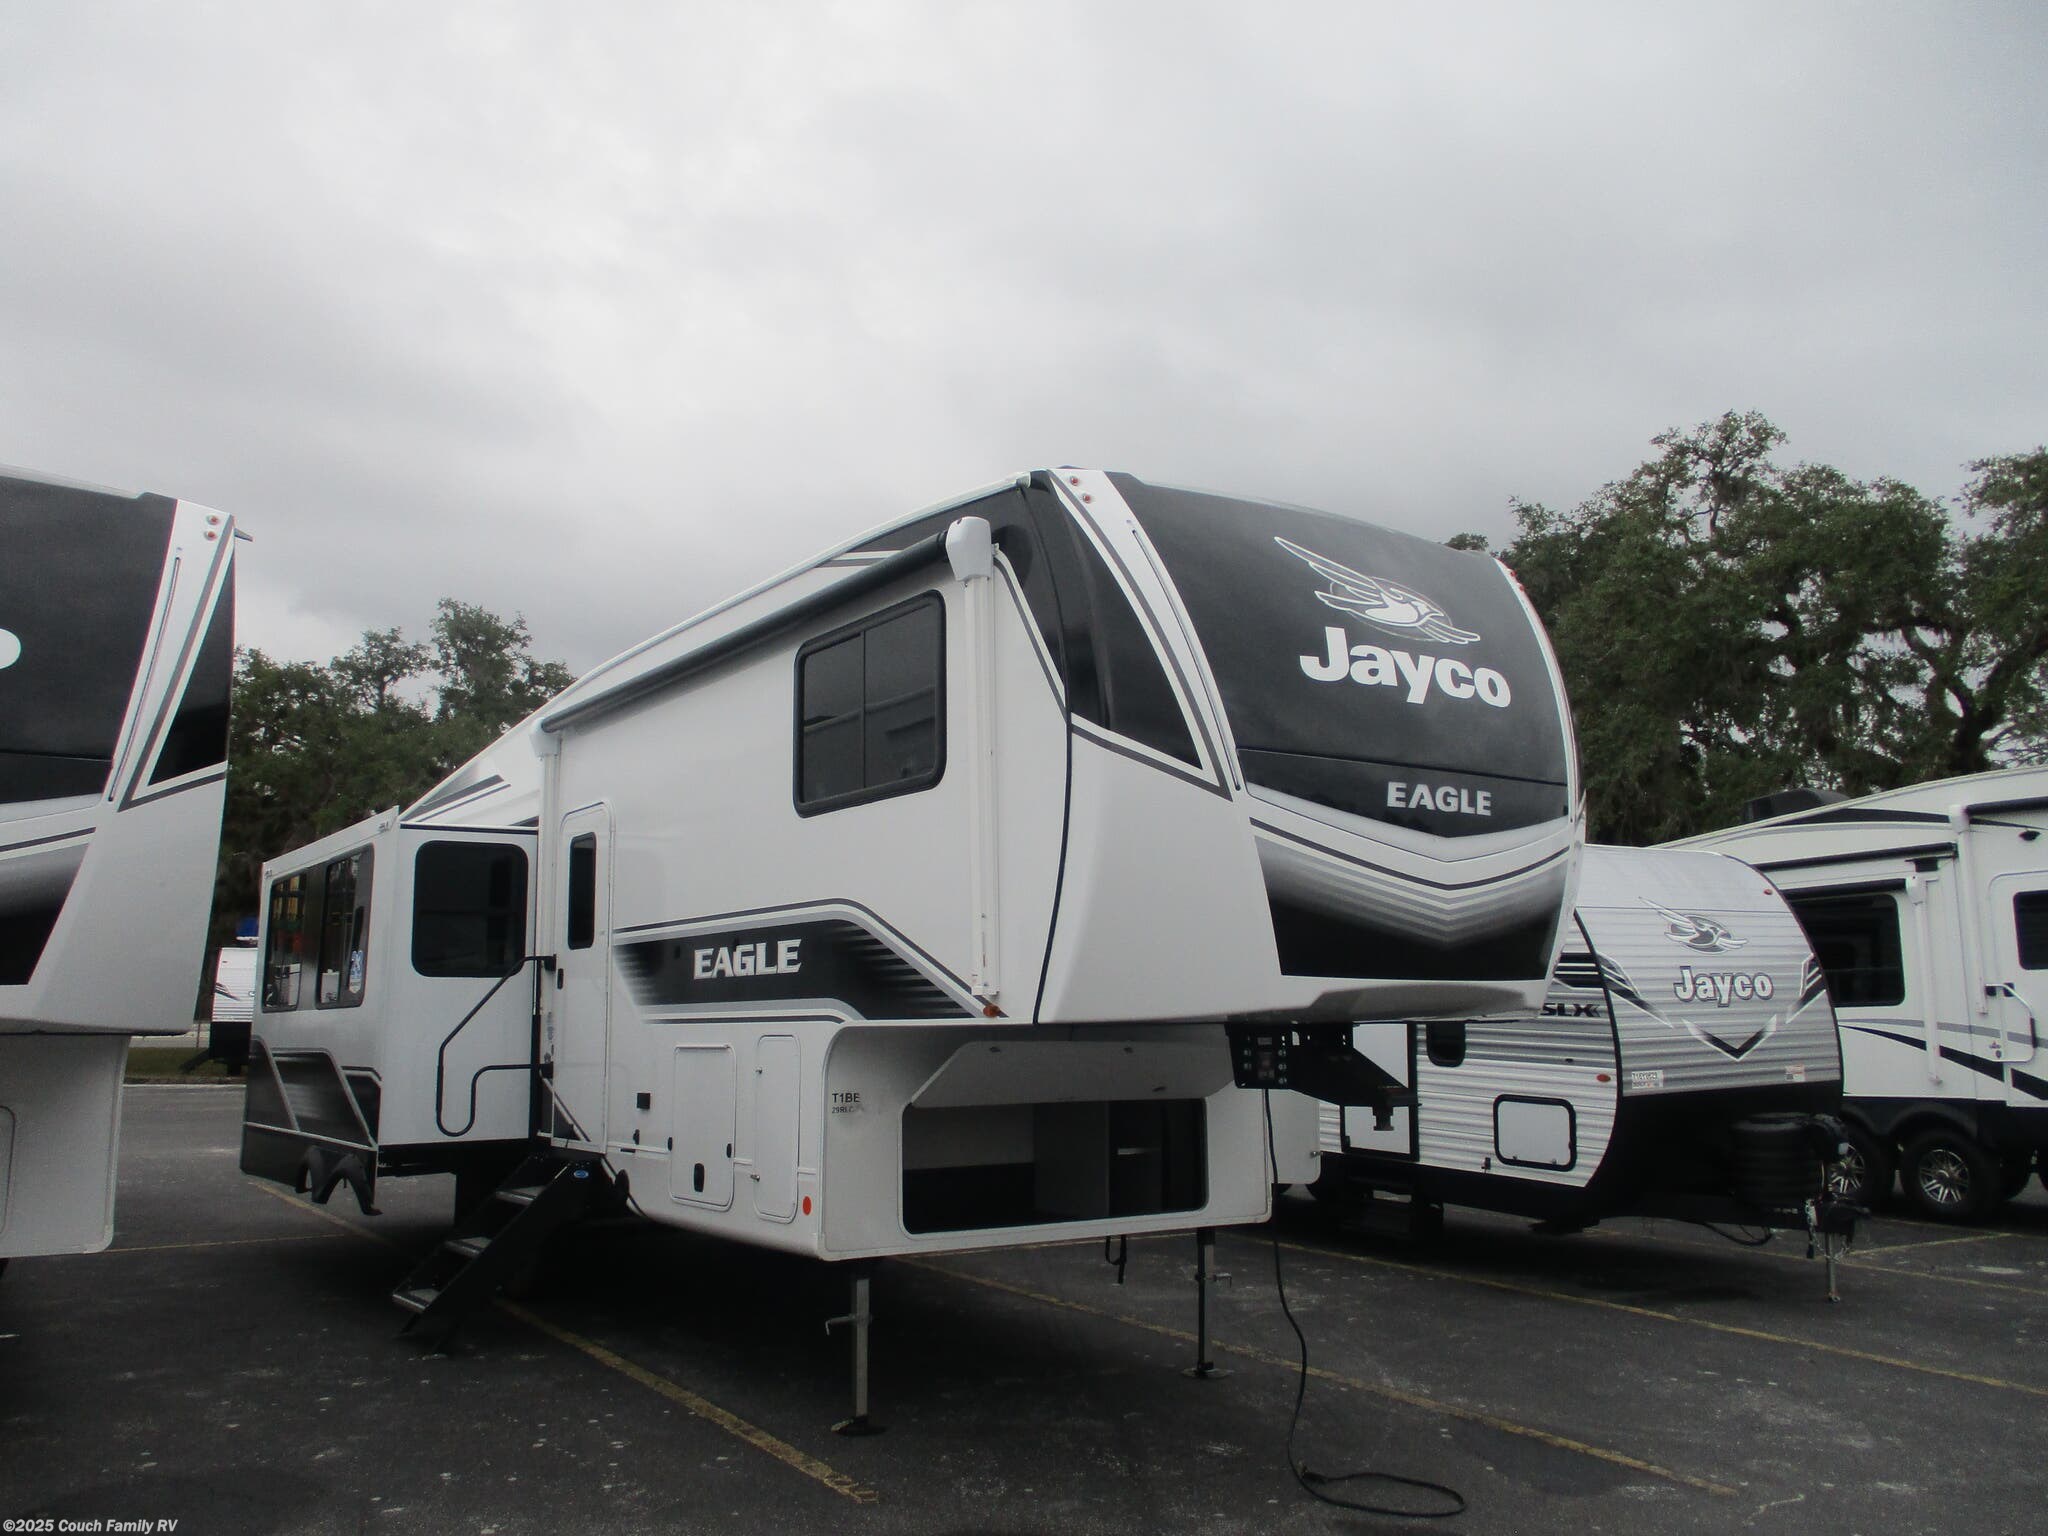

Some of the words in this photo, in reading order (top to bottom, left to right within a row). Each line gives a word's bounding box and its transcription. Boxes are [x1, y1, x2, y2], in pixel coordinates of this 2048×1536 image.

[1299, 626, 1511, 708] Jayco
[1387, 781, 1492, 816] EAGLE
[693, 939, 802, 980] EAGLE
[1673, 965, 1774, 1008] Jayco
[1540, 1002, 1601, 1017] SLX
